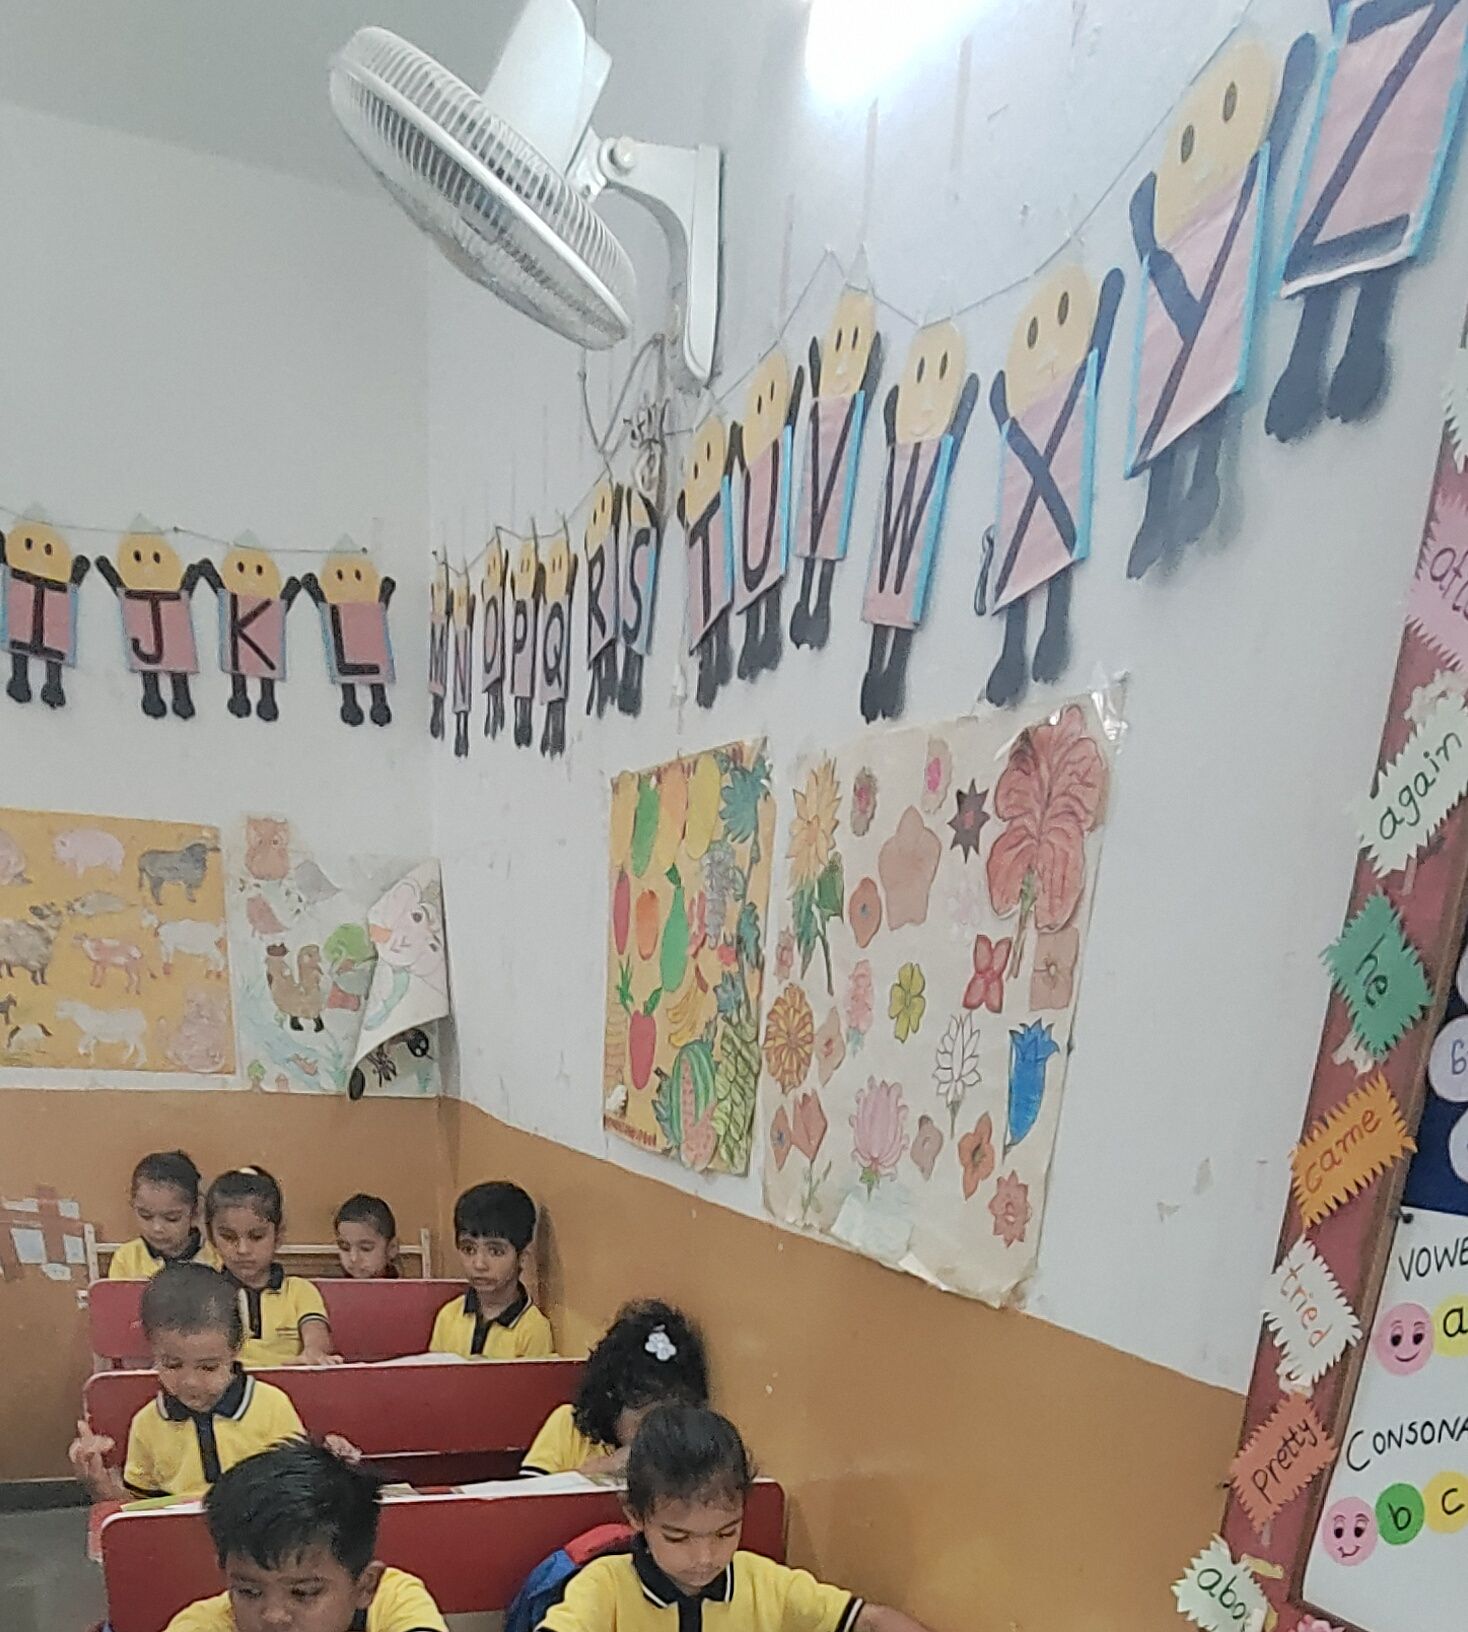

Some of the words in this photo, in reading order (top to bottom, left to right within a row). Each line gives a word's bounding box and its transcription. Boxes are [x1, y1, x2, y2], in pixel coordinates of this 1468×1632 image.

[689, 491, 721, 629] T
[743, 439, 779, 592] U
[810, 393, 856, 557] V
[878, 440, 943, 594] W
[995, 352, 1093, 602] X
[1131, 150, 1261, 476] Y
[1283, 0, 1461, 281] Z
[11, 569, 68, 660] I
[123, 589, 181, 664] J
[230, 593, 276, 671] K
[331, 604, 379, 676] L
[511, 599, 528, 693] P
[543, 602, 565, 689] Q
[587, 544, 607, 666] R
[622, 528, 650, 645] S
[1379, 731, 1462, 840] again
[1355, 933, 1388, 1007] he
[1305, 1107, 1382, 1192] came
[1280, 1264, 1333, 1349] tried
[1253, 1418, 1317, 1503] pretty
[1388, 1502, 1412, 1531] b
